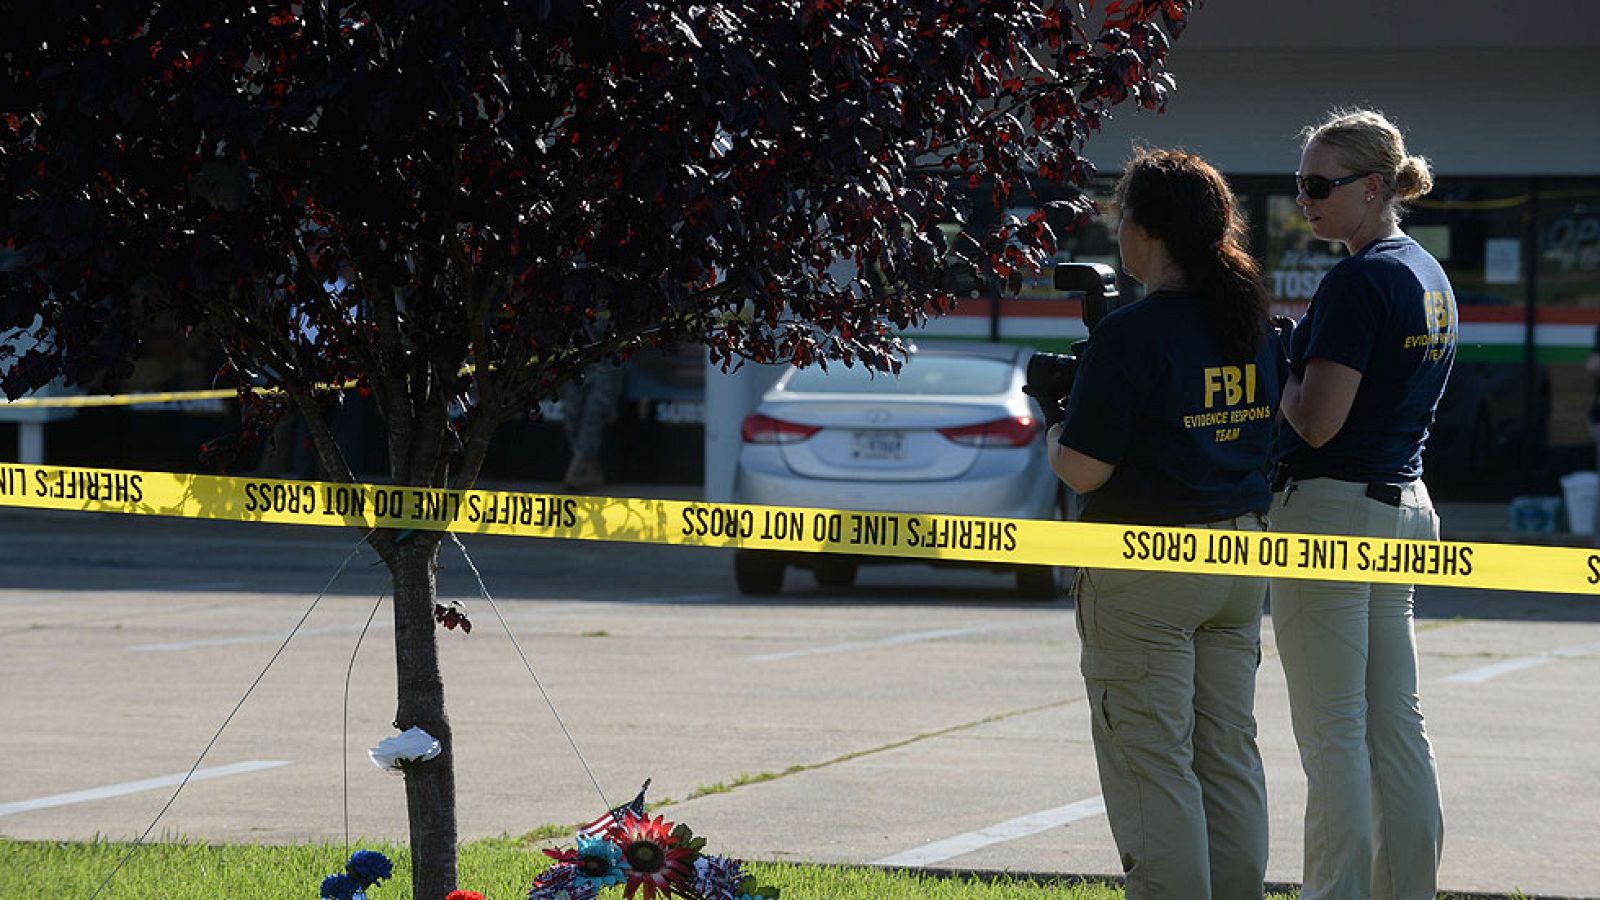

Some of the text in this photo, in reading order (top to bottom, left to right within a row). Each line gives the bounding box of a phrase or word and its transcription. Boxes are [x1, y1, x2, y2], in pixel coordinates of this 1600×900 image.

[1204, 364, 1256, 408] FBI
[1183, 405, 1271, 429] EVIDENCE RESPONS
[1215, 427, 1241, 442] TEAM
[0, 468, 143, 504] SHERIFF'S LIN
[245, 483, 576, 528] SHERIFF'S LINE DO NOT CROSS
[682, 507, 1017, 552] SHERIFF'S LINE DO NOT CROSS
[1122, 530, 1473, 576] SHERIFF'S LINE DO NOT CROSS
